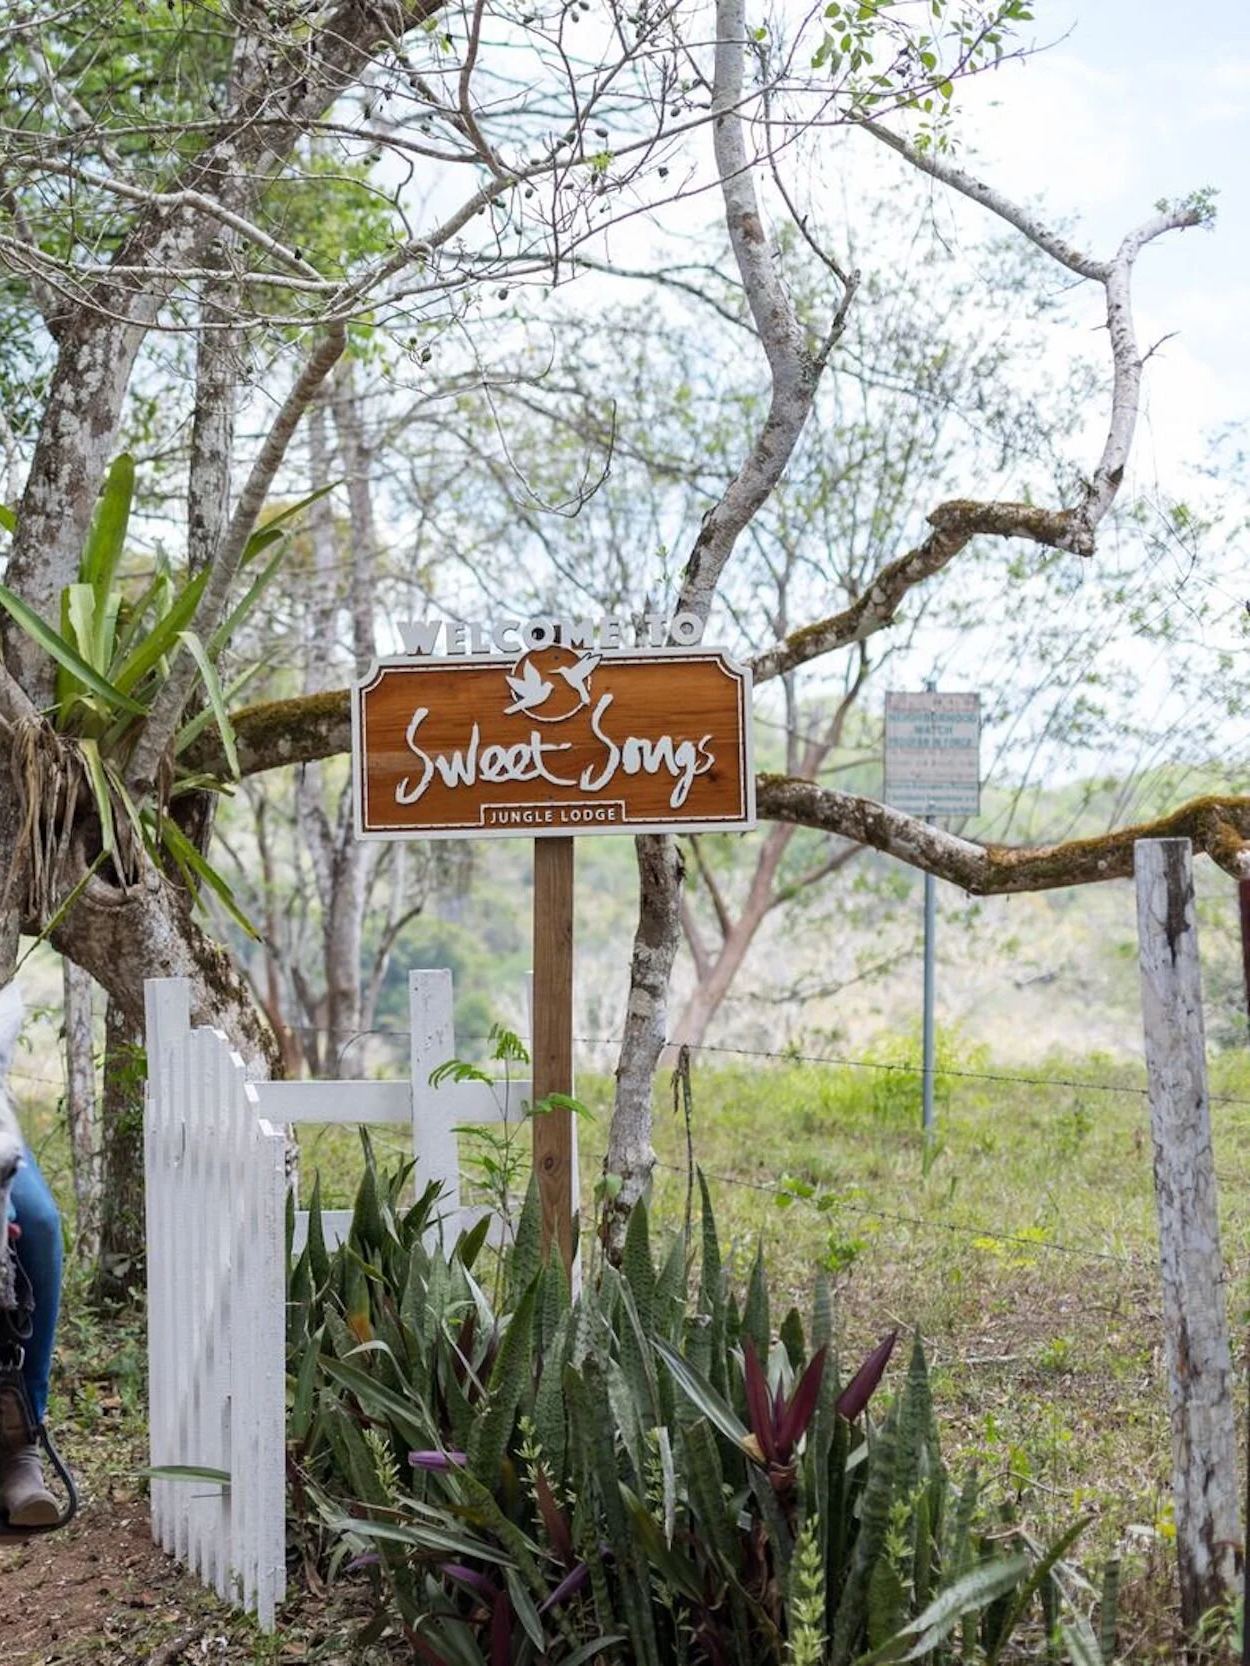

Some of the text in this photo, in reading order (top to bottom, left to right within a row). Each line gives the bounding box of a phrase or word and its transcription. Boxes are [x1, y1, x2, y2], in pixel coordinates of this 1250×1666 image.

[396, 611, 704, 656] WELCOME TO
[394, 693, 715, 809] Sweet Songs
[490, 807, 616, 824] JUNGLE LODGE
